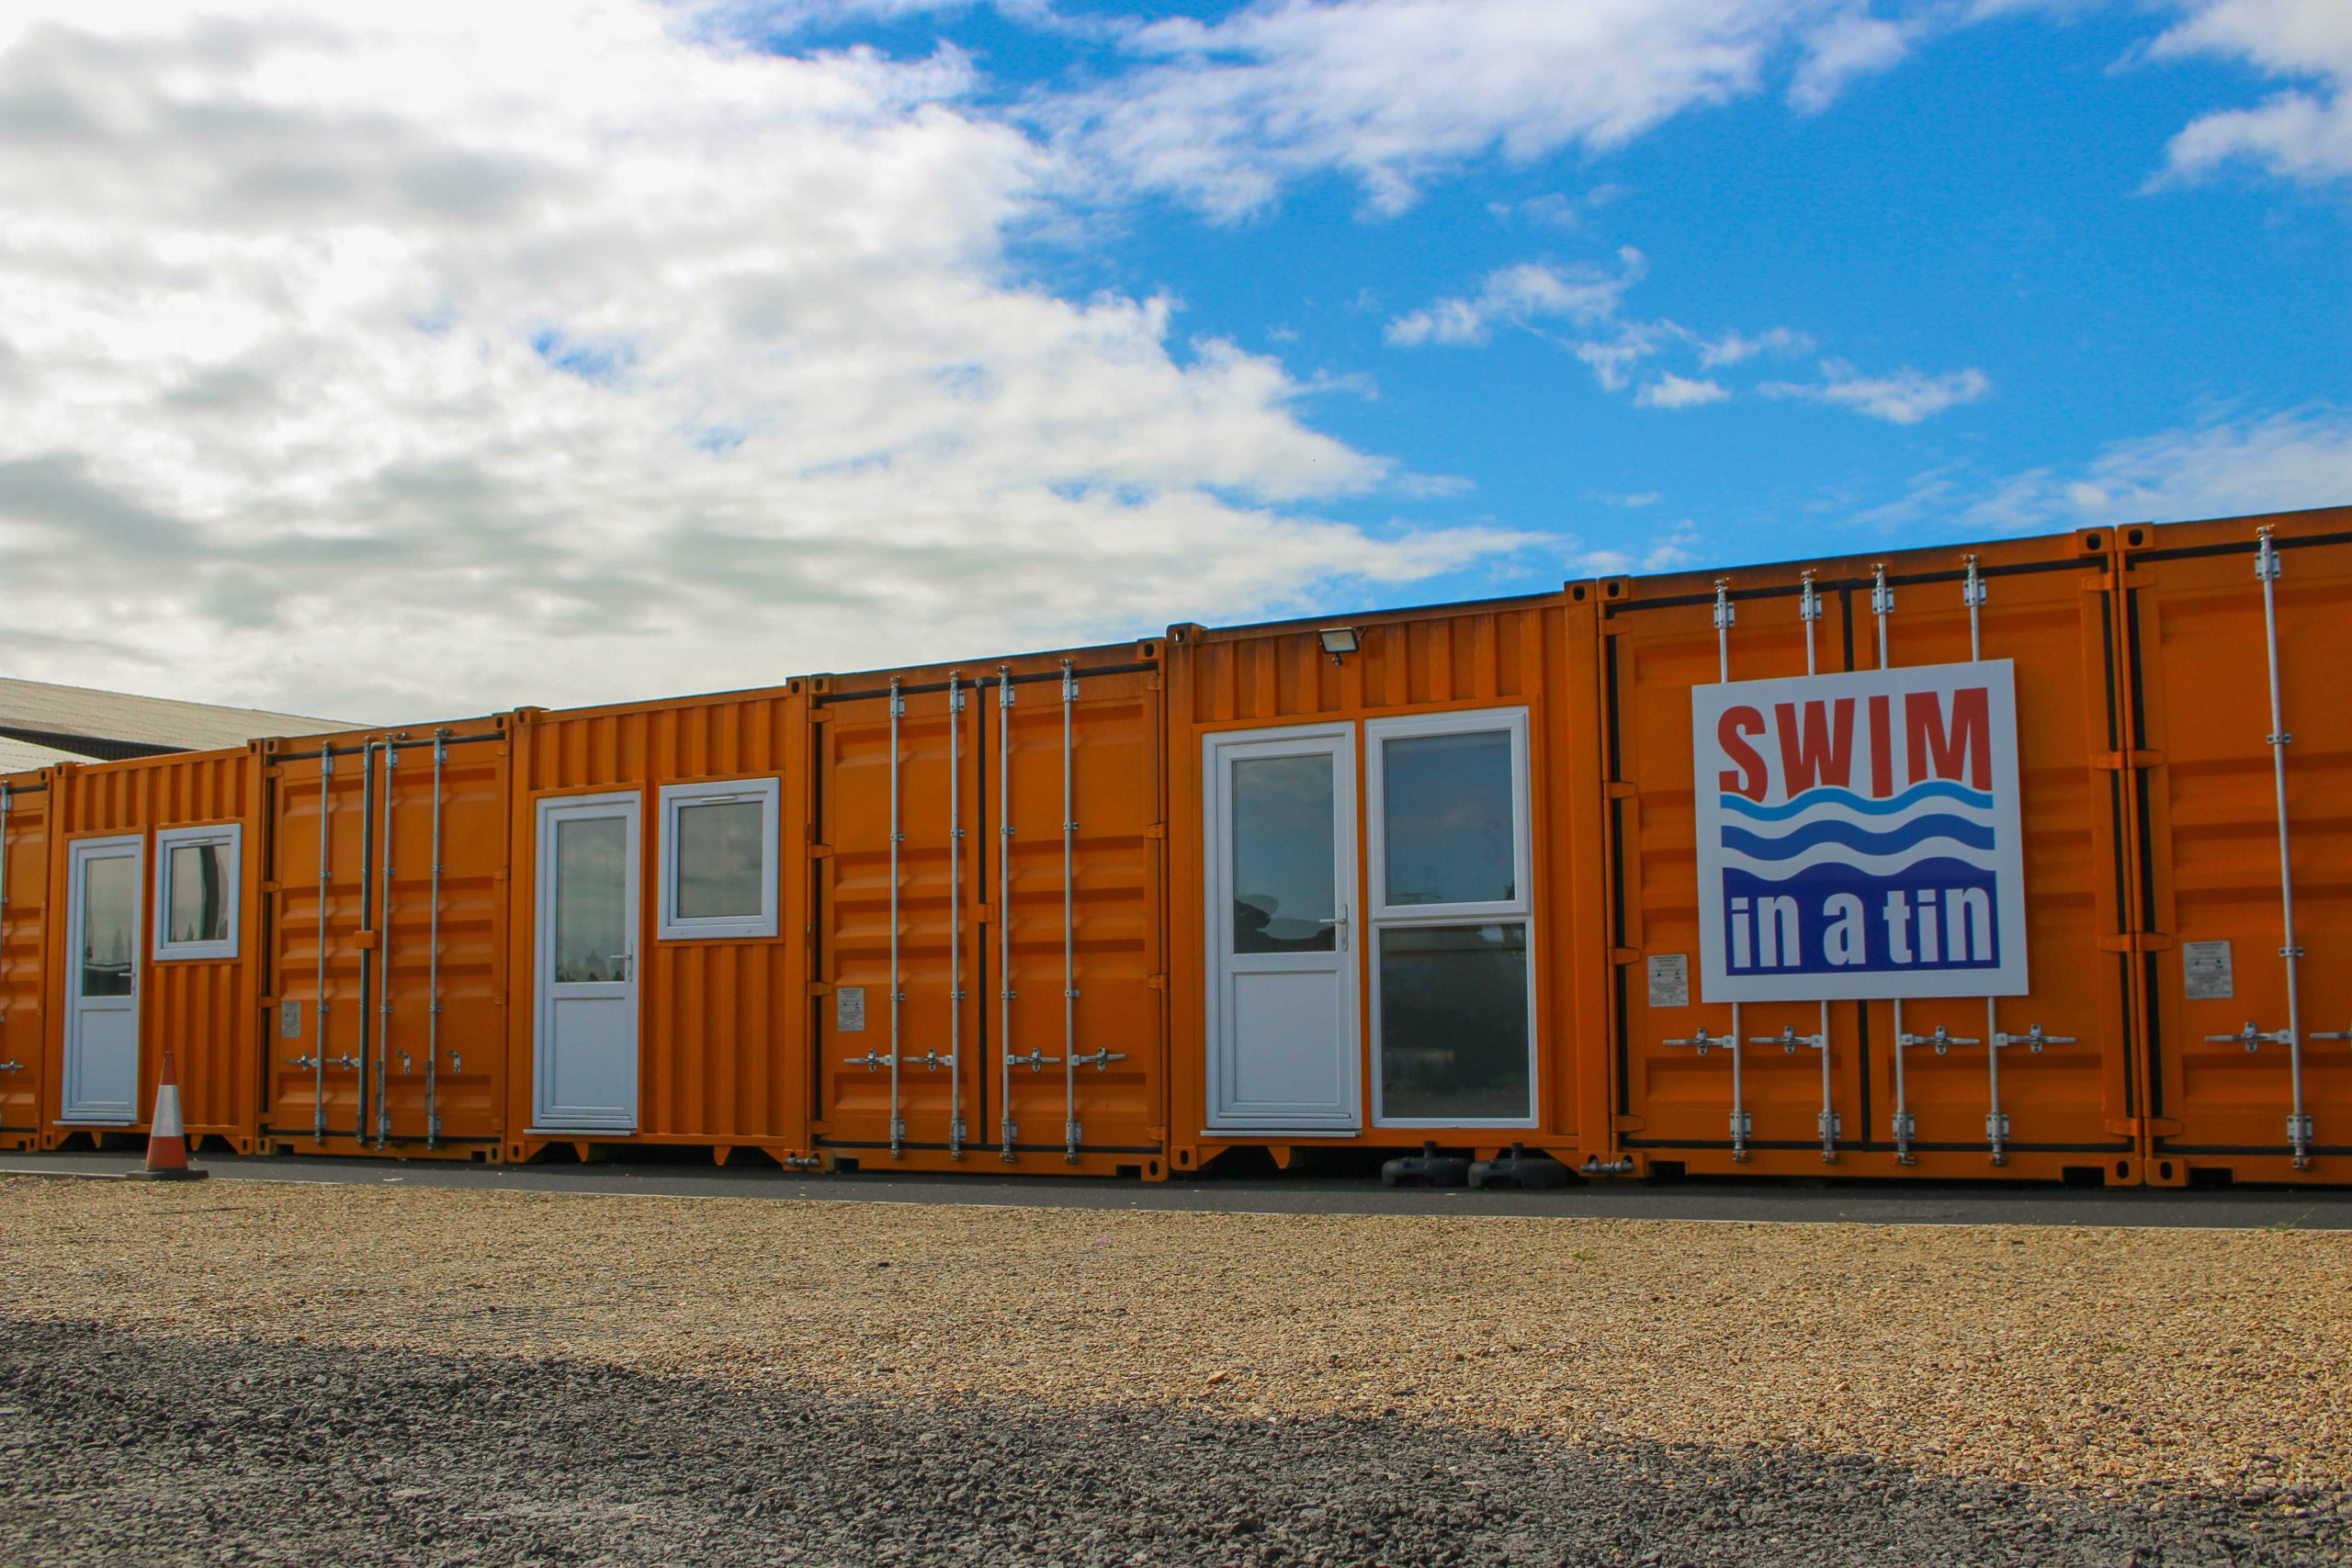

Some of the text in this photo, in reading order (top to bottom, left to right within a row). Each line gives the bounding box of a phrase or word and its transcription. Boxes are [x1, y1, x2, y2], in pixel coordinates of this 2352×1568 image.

[1717, 687, 1992, 802] SWIM
[1732, 886, 1992, 968] in a tin
